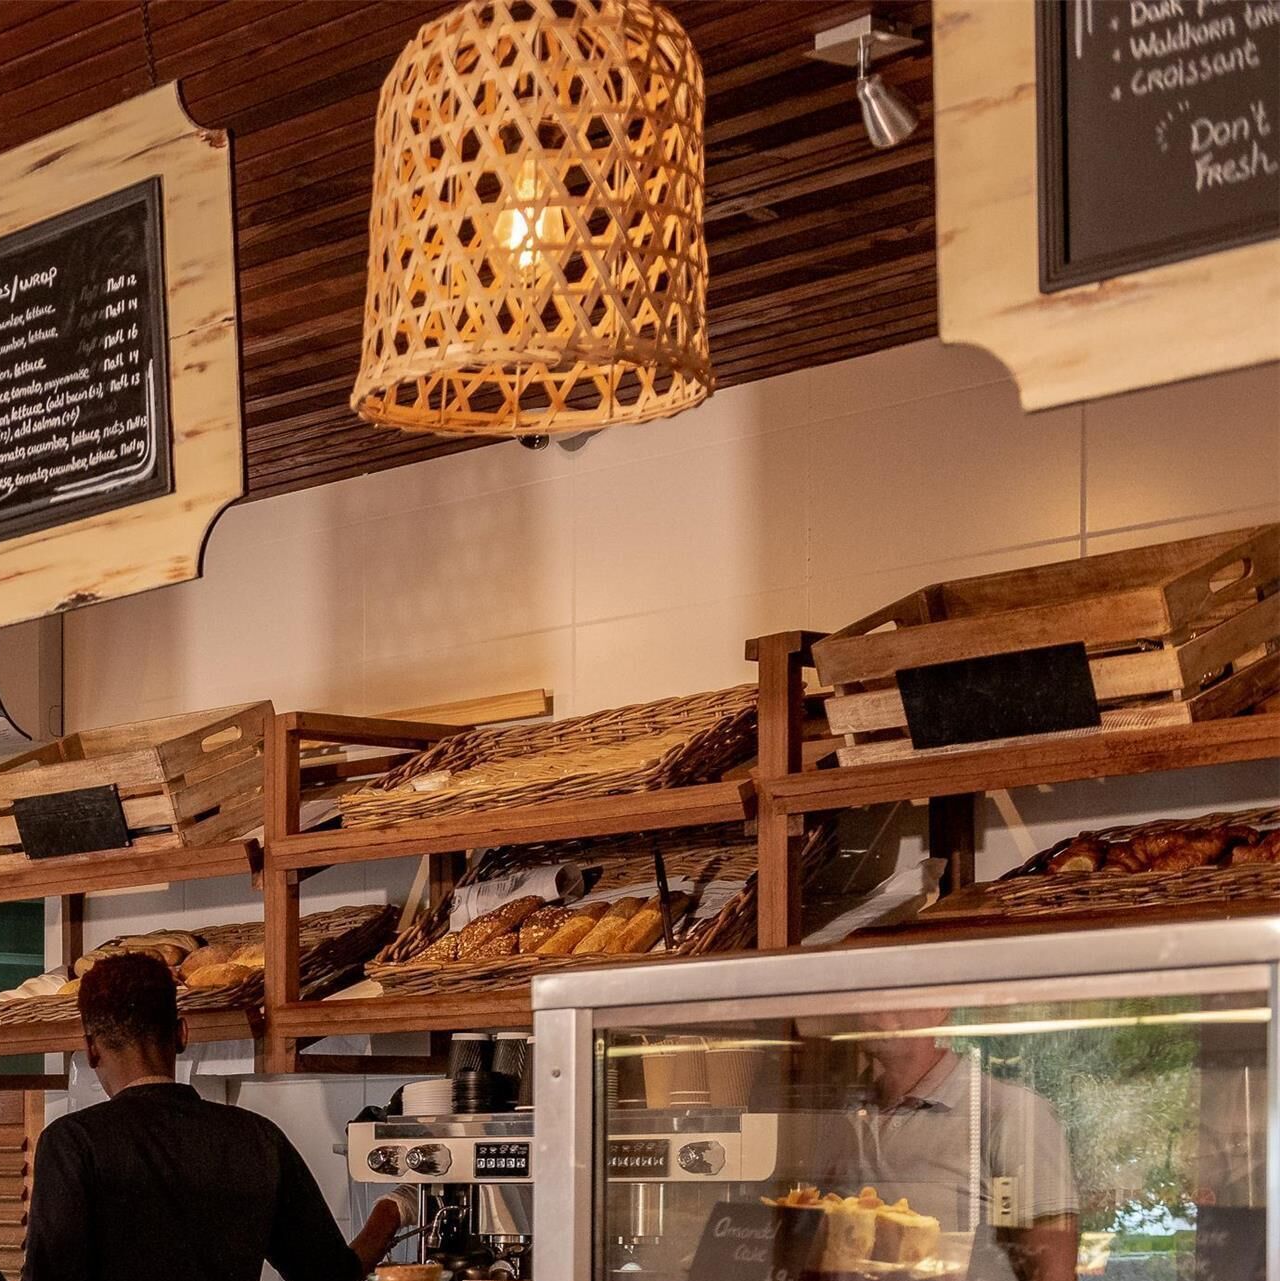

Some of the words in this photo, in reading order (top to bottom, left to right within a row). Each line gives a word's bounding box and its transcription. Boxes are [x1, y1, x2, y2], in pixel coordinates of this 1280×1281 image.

[126, 273, 137, 287] 12
[128, 297, 138, 310] 14
[127, 323, 138, 340] 16
[128, 349, 139, 364] 14
[130, 372, 141, 386] 13
[14, 418, 32, 439] add
